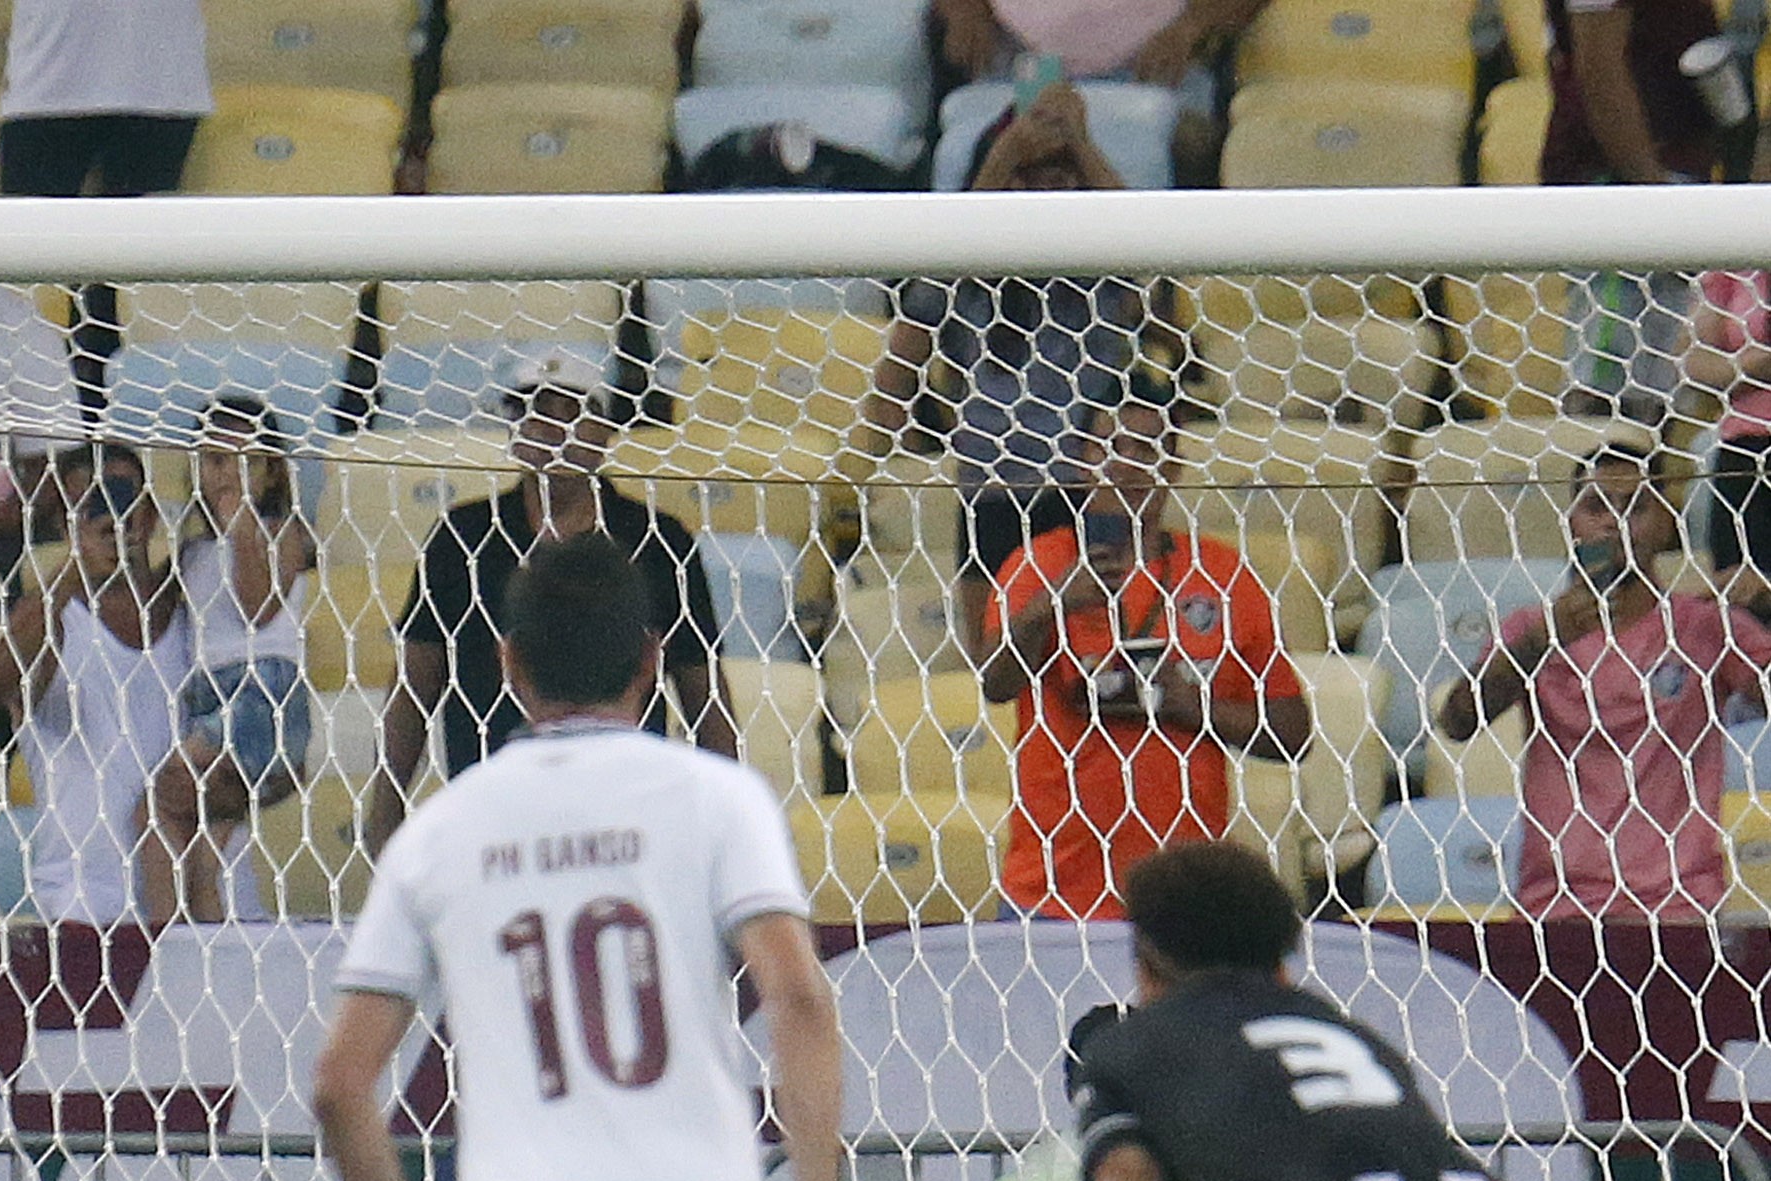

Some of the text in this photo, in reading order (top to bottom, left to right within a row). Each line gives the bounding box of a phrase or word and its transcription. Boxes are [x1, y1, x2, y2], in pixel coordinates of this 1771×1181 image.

[535, 828, 642, 874] GANSO
[497, 896, 669, 1100] 10
[1242, 1014, 1406, 1113] 3
